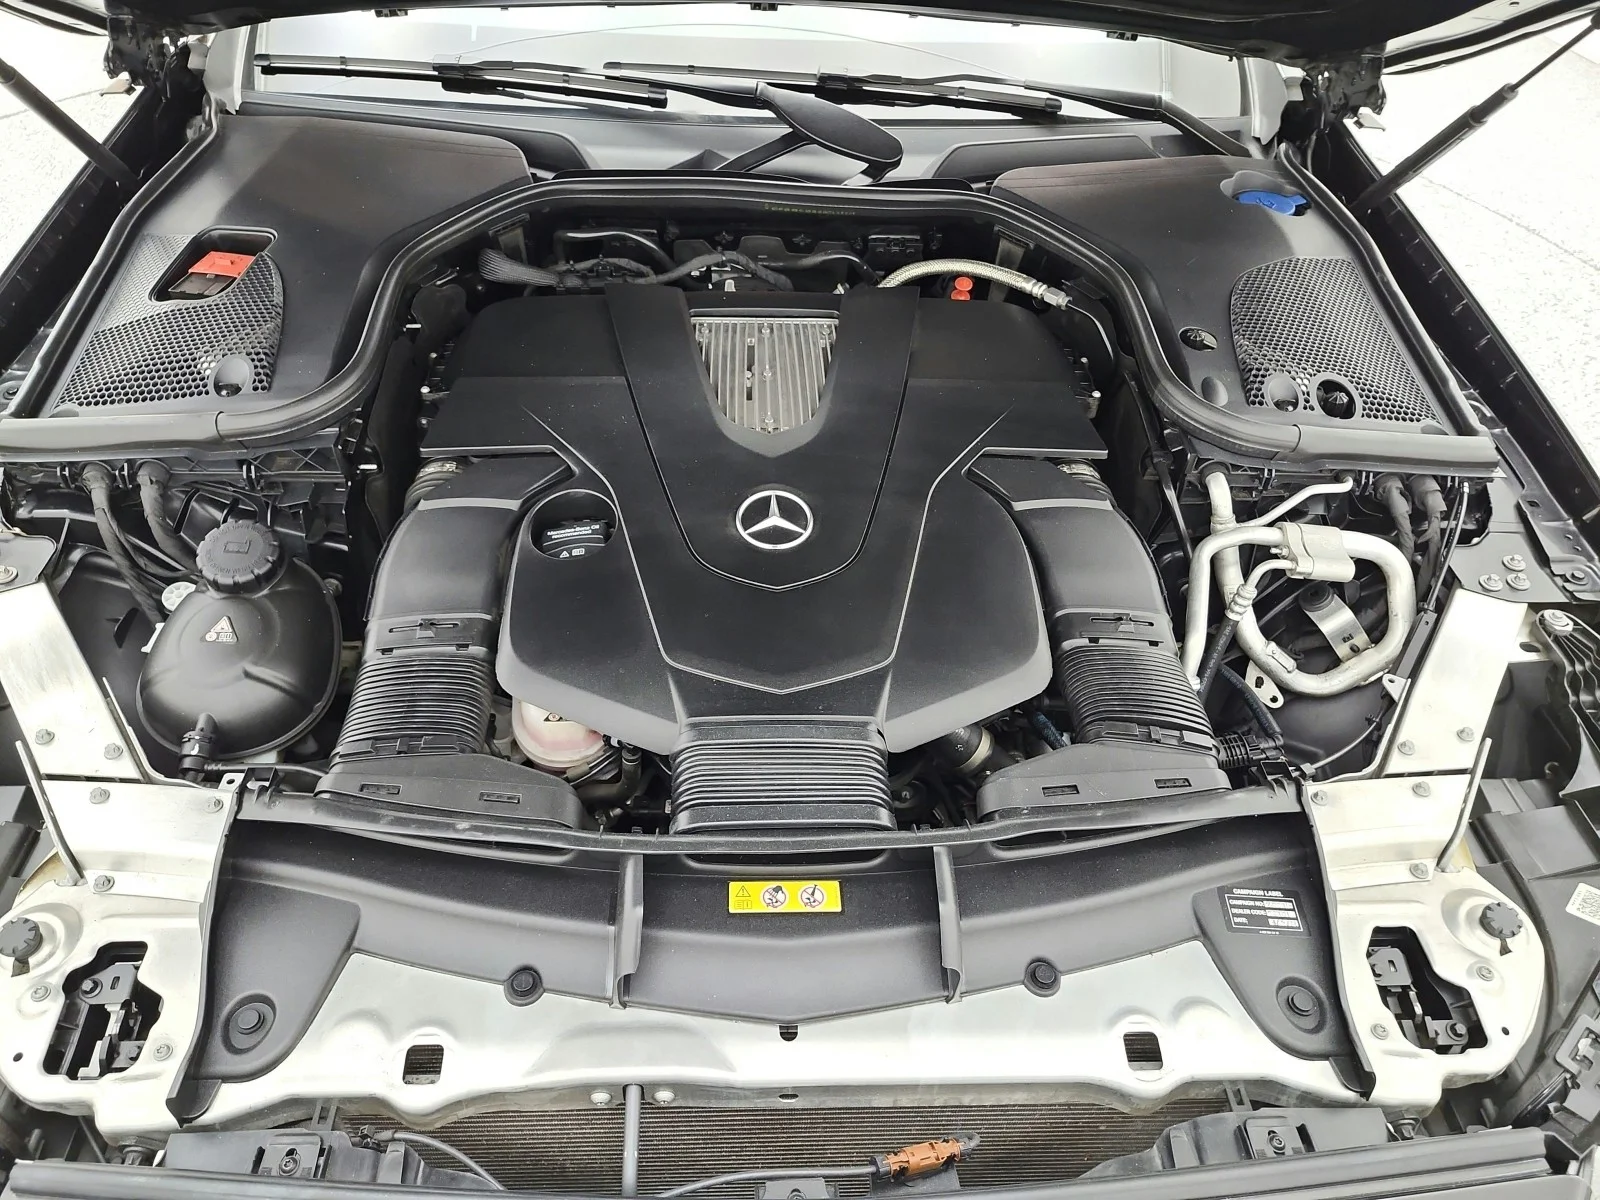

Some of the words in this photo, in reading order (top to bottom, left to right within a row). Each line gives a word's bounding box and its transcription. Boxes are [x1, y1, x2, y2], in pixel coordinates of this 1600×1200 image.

[547, 526, 591, 535] Mercedes-Benz
[552, 530, 592, 539] recommended
[1233, 888, 1264, 896] CAMPAIGN
